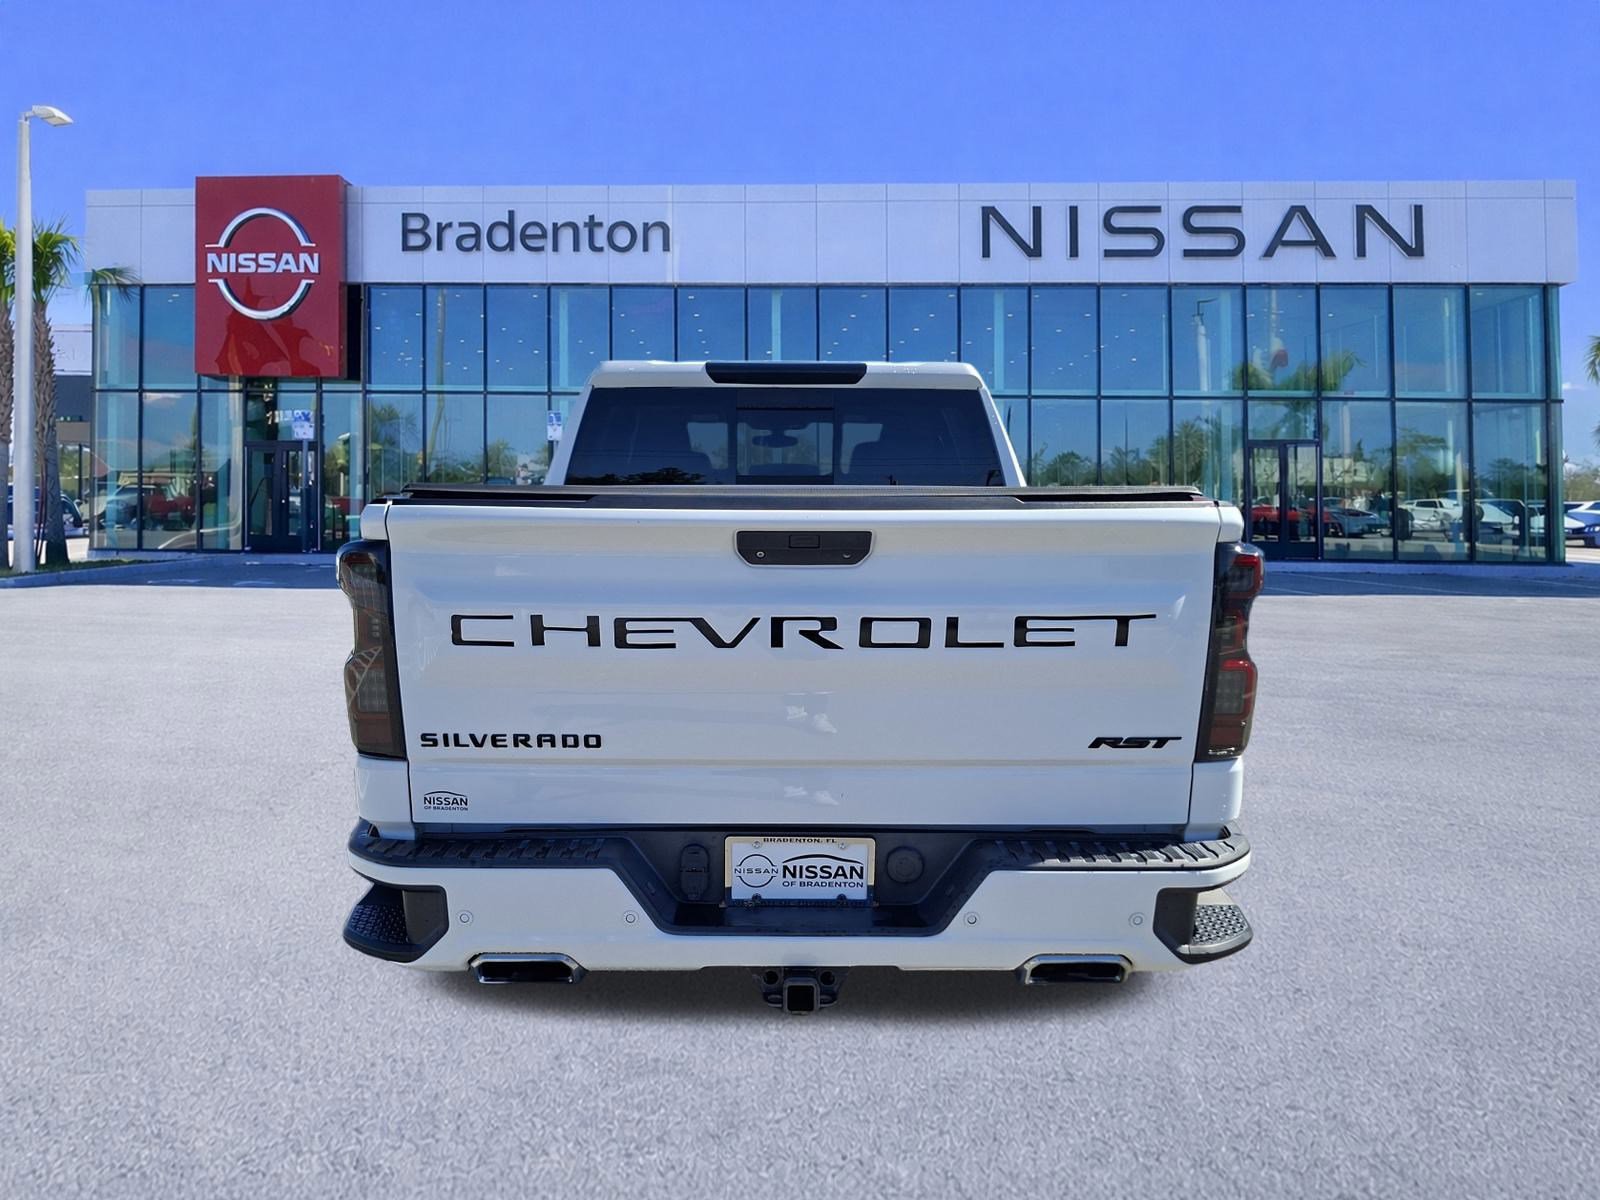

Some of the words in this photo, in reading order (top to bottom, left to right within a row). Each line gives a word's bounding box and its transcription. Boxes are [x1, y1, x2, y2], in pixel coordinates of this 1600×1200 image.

[401, 209, 671, 254] Bradenton
[980, 204, 1425, 259] NISSAN
[206, 252, 319, 275] NISSAN
[450, 613, 1157, 650] CHEVROLET
[420, 732, 602, 749] SILVERADO
[1087, 736, 1183, 749] RST
[423, 795, 468, 806] NISSAN
[734, 867, 779, 875] NISSAN
[782, 864, 864, 880] NISSAN
[782, 880, 797, 888] OF
[799, 880, 864, 889] BRADENTON
